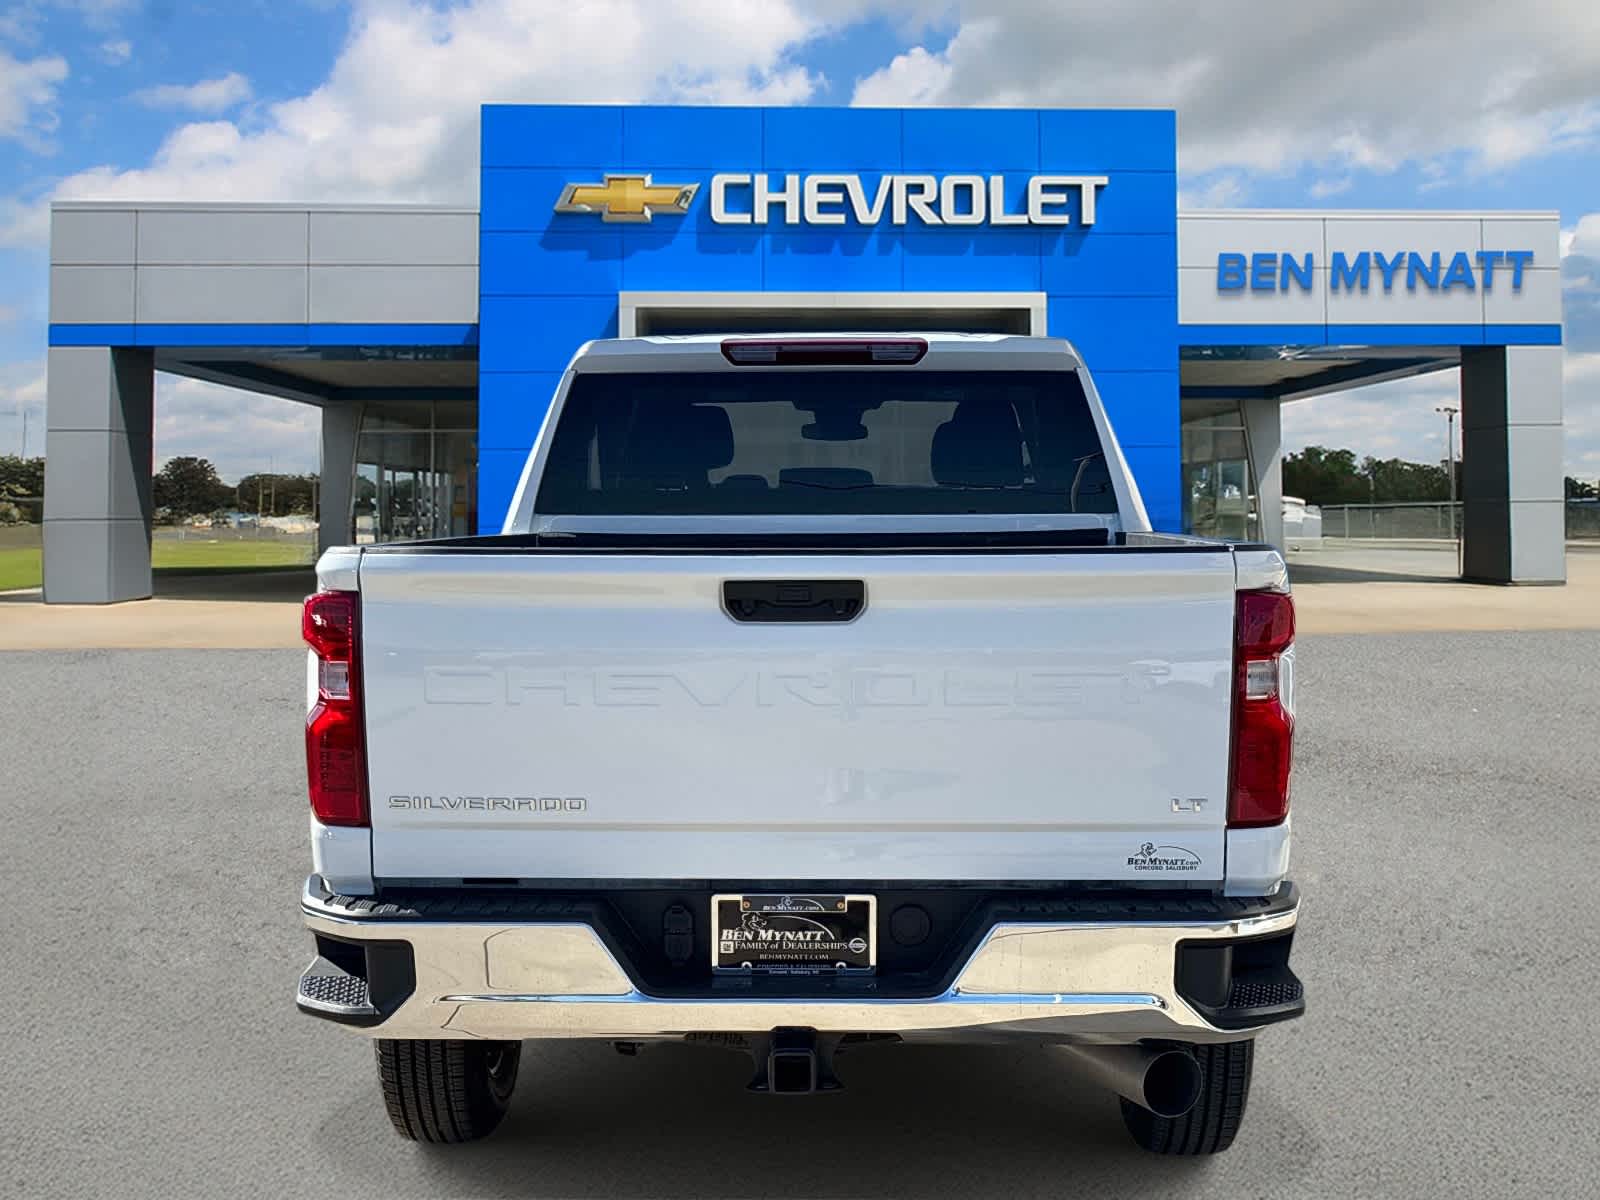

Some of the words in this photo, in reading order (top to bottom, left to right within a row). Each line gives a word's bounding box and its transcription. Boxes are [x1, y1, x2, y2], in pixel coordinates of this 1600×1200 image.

[710, 173, 1110, 226] CHEVROLET
[1217, 252, 1313, 290] BEN
[1329, 250, 1534, 290] MYNATT
[388, 795, 588, 812] SILVERADO
[1170, 798, 1208, 813] LT
[720, 929, 754, 941] BEN
[757, 929, 825, 941] MYNATT
[735, 941, 768, 950] FAMILY
[782, 941, 848, 950] DEALERSHIPS
